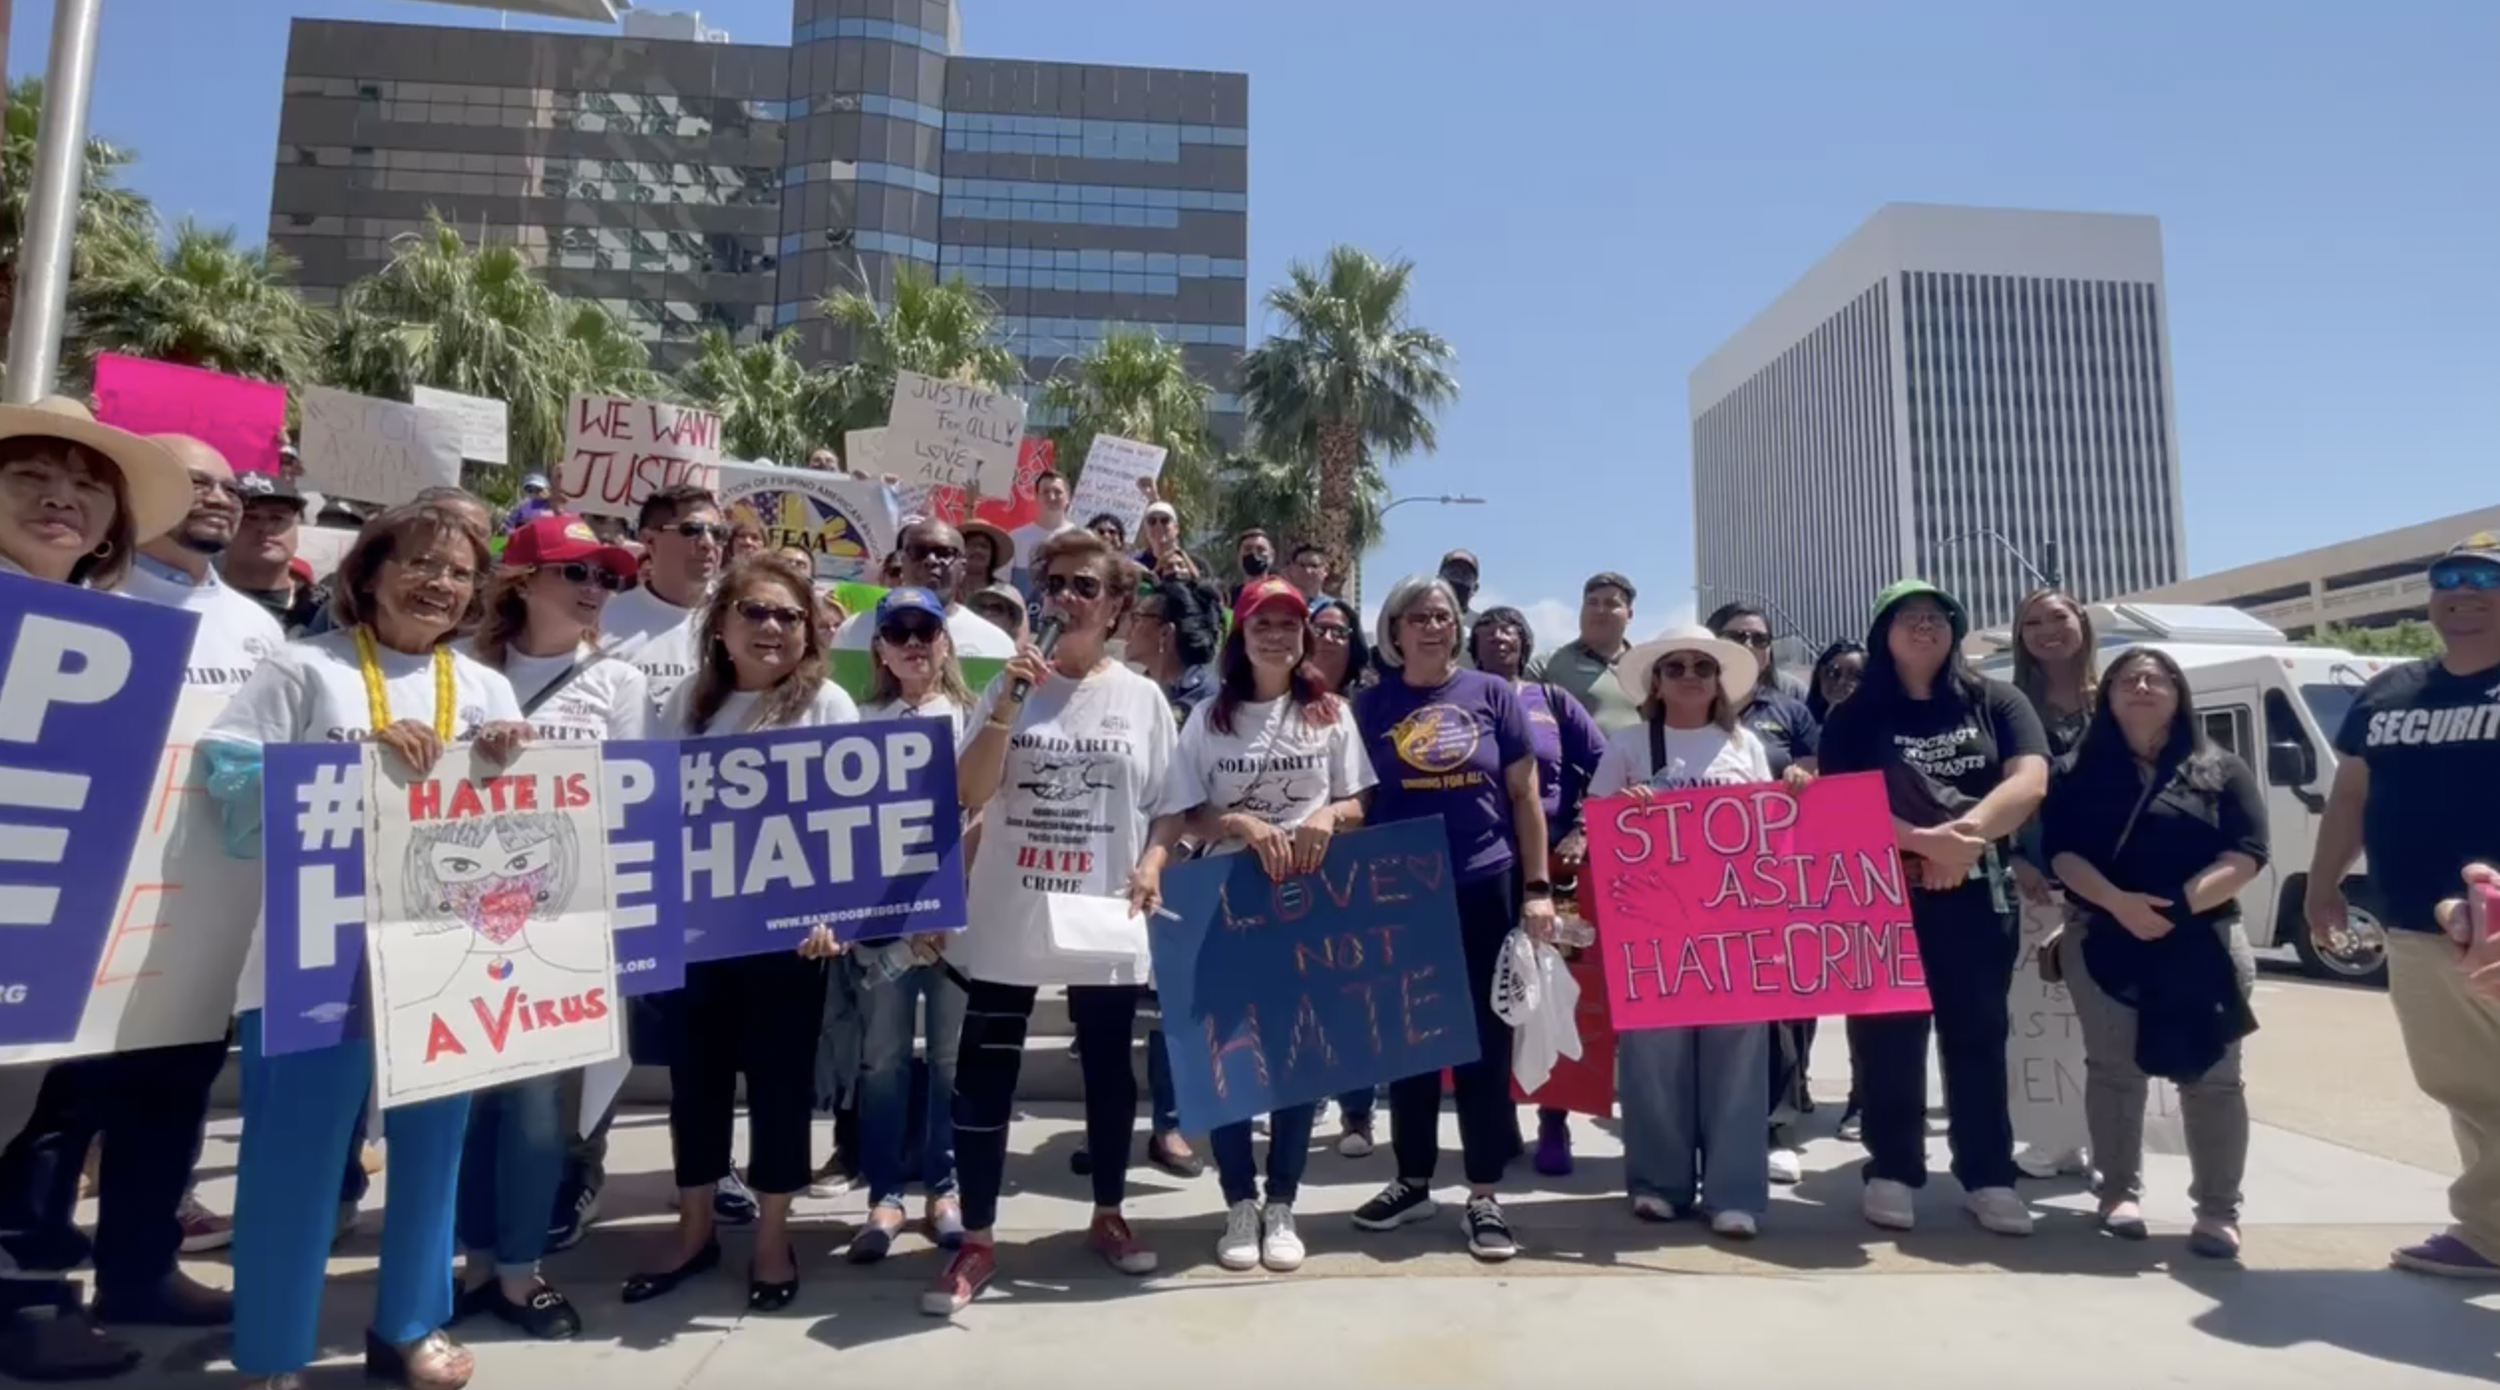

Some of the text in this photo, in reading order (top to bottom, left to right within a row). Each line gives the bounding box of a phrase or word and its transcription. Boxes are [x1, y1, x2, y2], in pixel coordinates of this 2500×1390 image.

[911, 377, 997, 414] JUSTICE
[580, 400, 723, 450] WE WANT
[915, 440, 968, 468] LOVE
[919, 462, 960, 483] ALL
[770, 476, 816, 491] FILIPINO
[817, 484, 863, 524] AMERICAN
[1010, 733, 1135, 755] SOLIDARITY
[407, 773, 592, 822] HATE IS
[681, 732, 933, 816] #STOP
[682, 800, 939, 902] HATE
[1613, 791, 1799, 866] STOP
[1017, 847, 1094, 873] HATE
[1022, 875, 1082, 893] CRIME
[1704, 846, 1903, 911] ASIAN
[1219, 858, 1412, 931] LOVE
[1294, 924, 1403, 973] NOT
[1621, 922, 1926, 1001] HATE CRIME
[424, 1011, 467, 1064] A
[1203, 966, 1449, 1101] HATE
